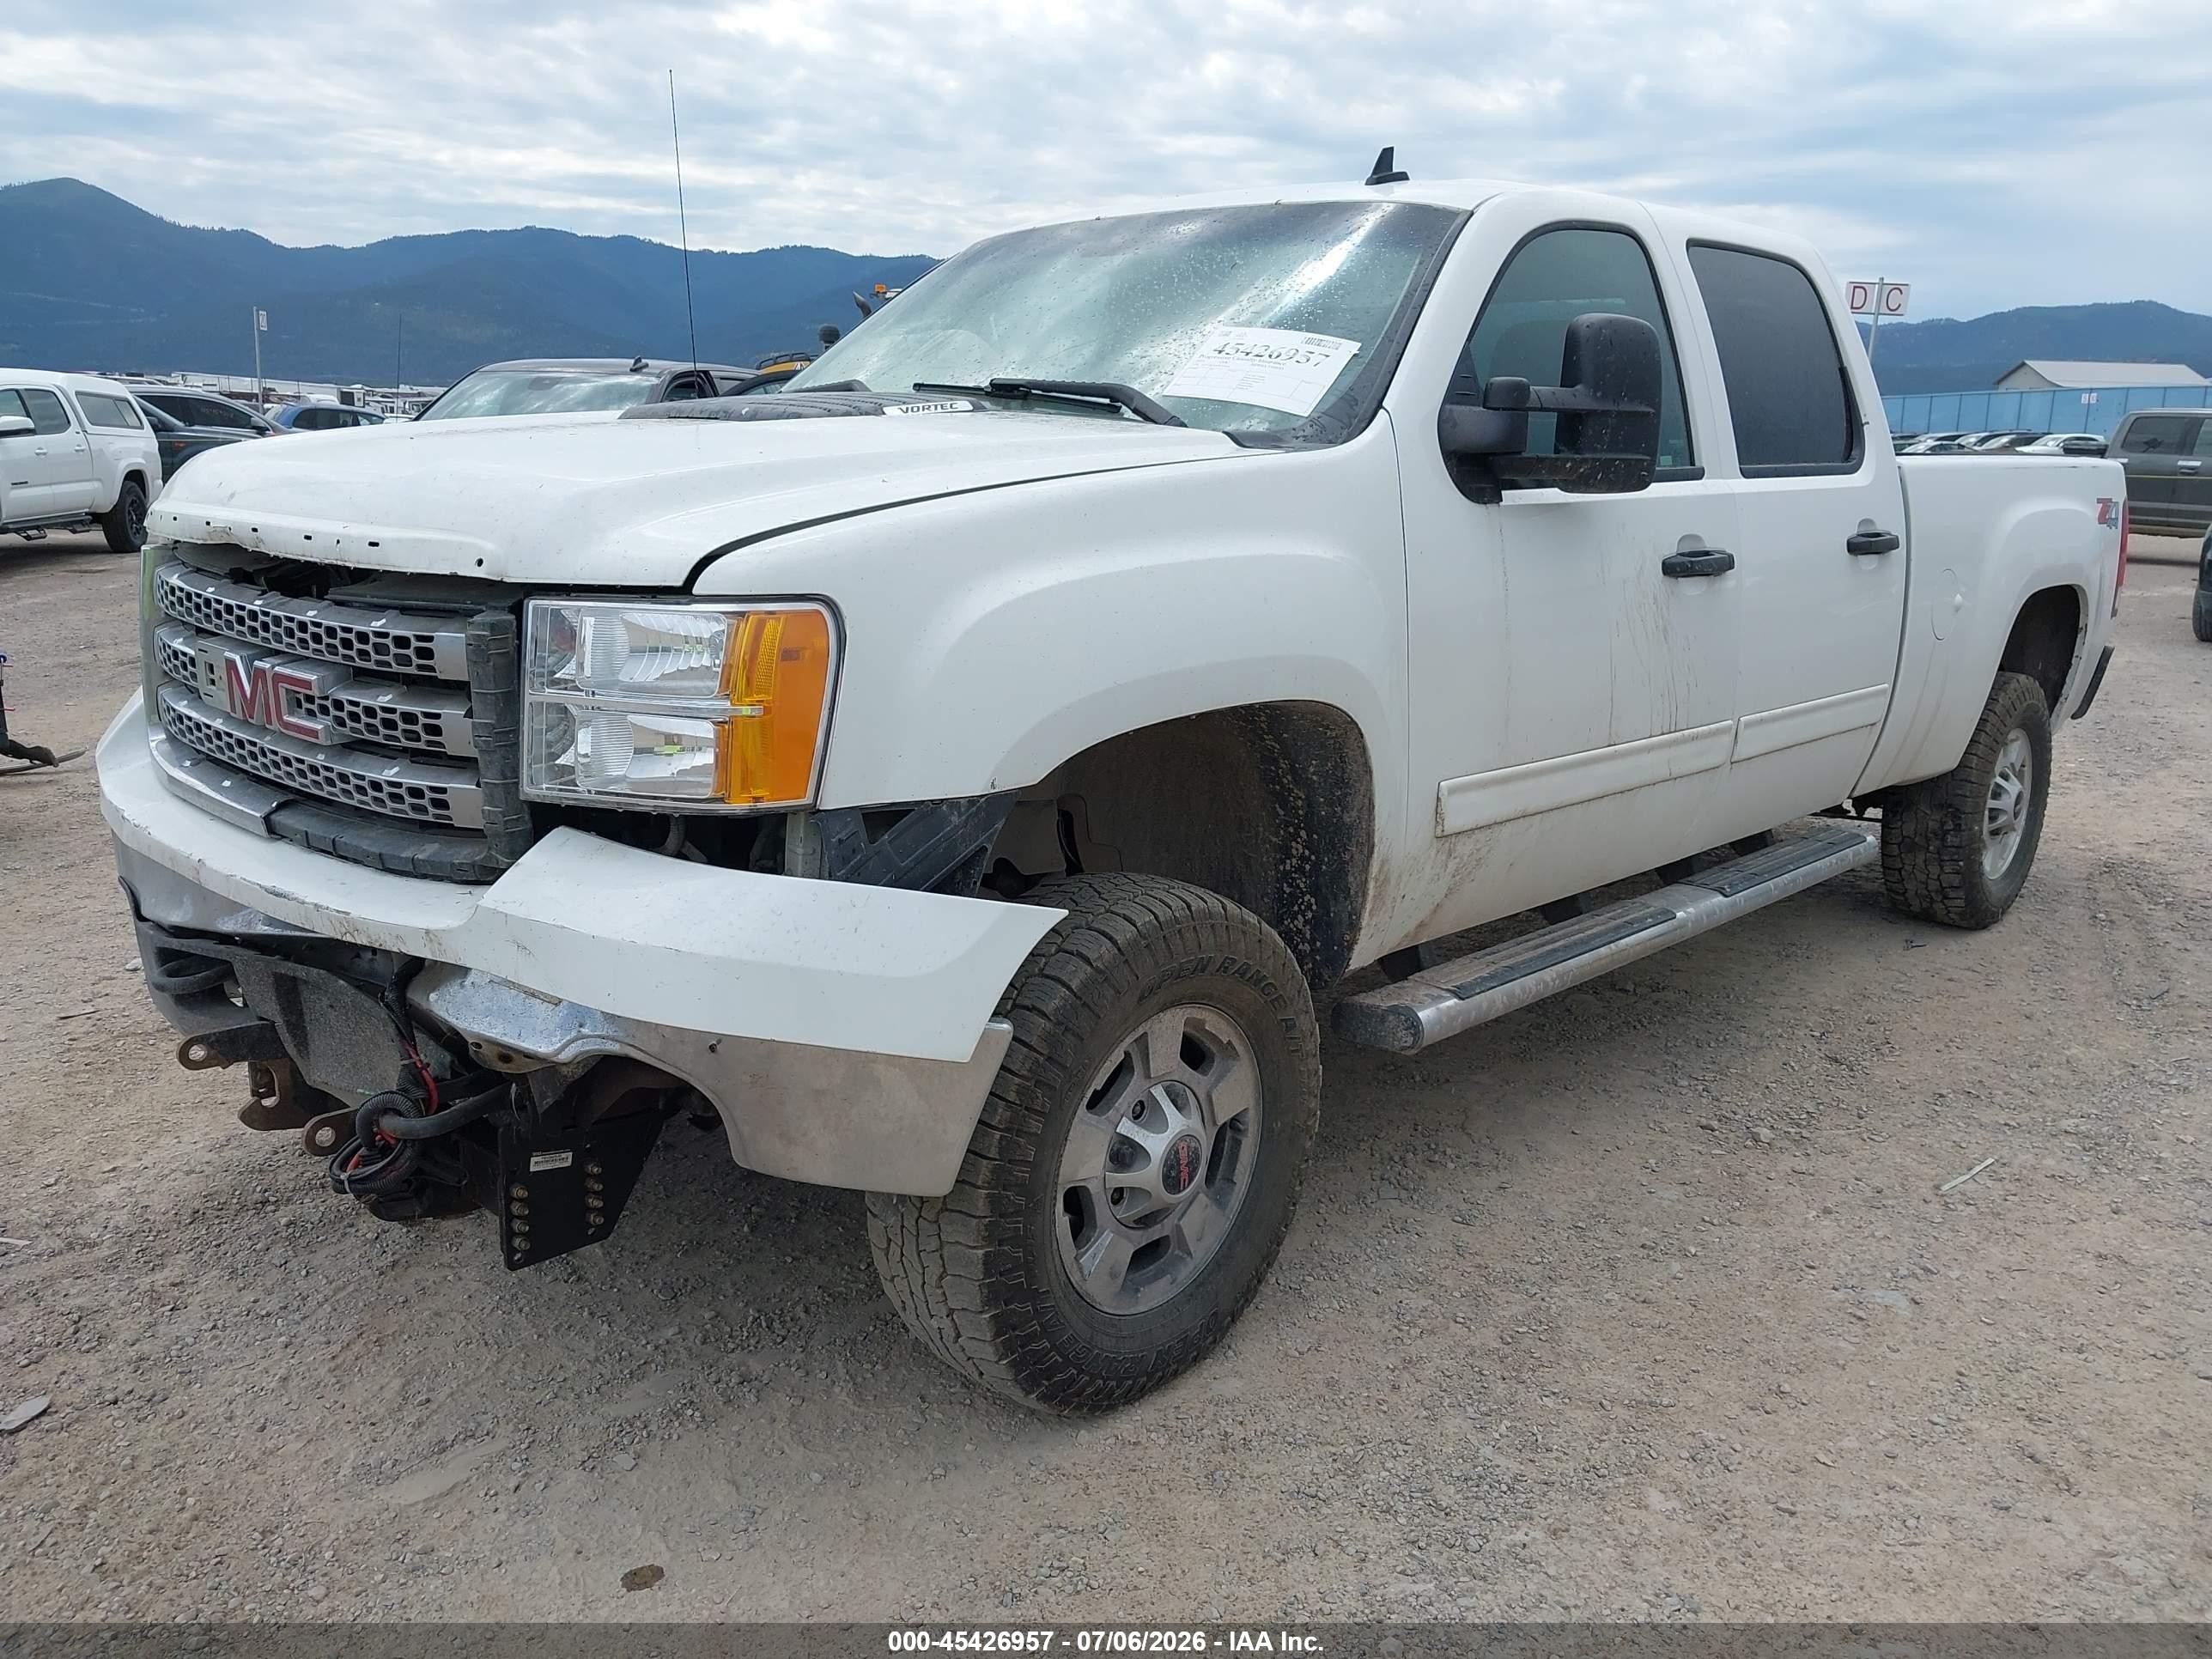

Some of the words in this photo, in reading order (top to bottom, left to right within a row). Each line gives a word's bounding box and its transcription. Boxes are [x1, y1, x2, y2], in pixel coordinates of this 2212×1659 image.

[1850, 285, 1868, 310] D
[1886, 287, 1903, 312] C
[1213, 342, 1331, 367] 45426957
[897, 402, 959, 414] VORTEC
[1138, 953, 1215, 1004] OPEN
[1215, 953, 1289, 1012] RANGE
